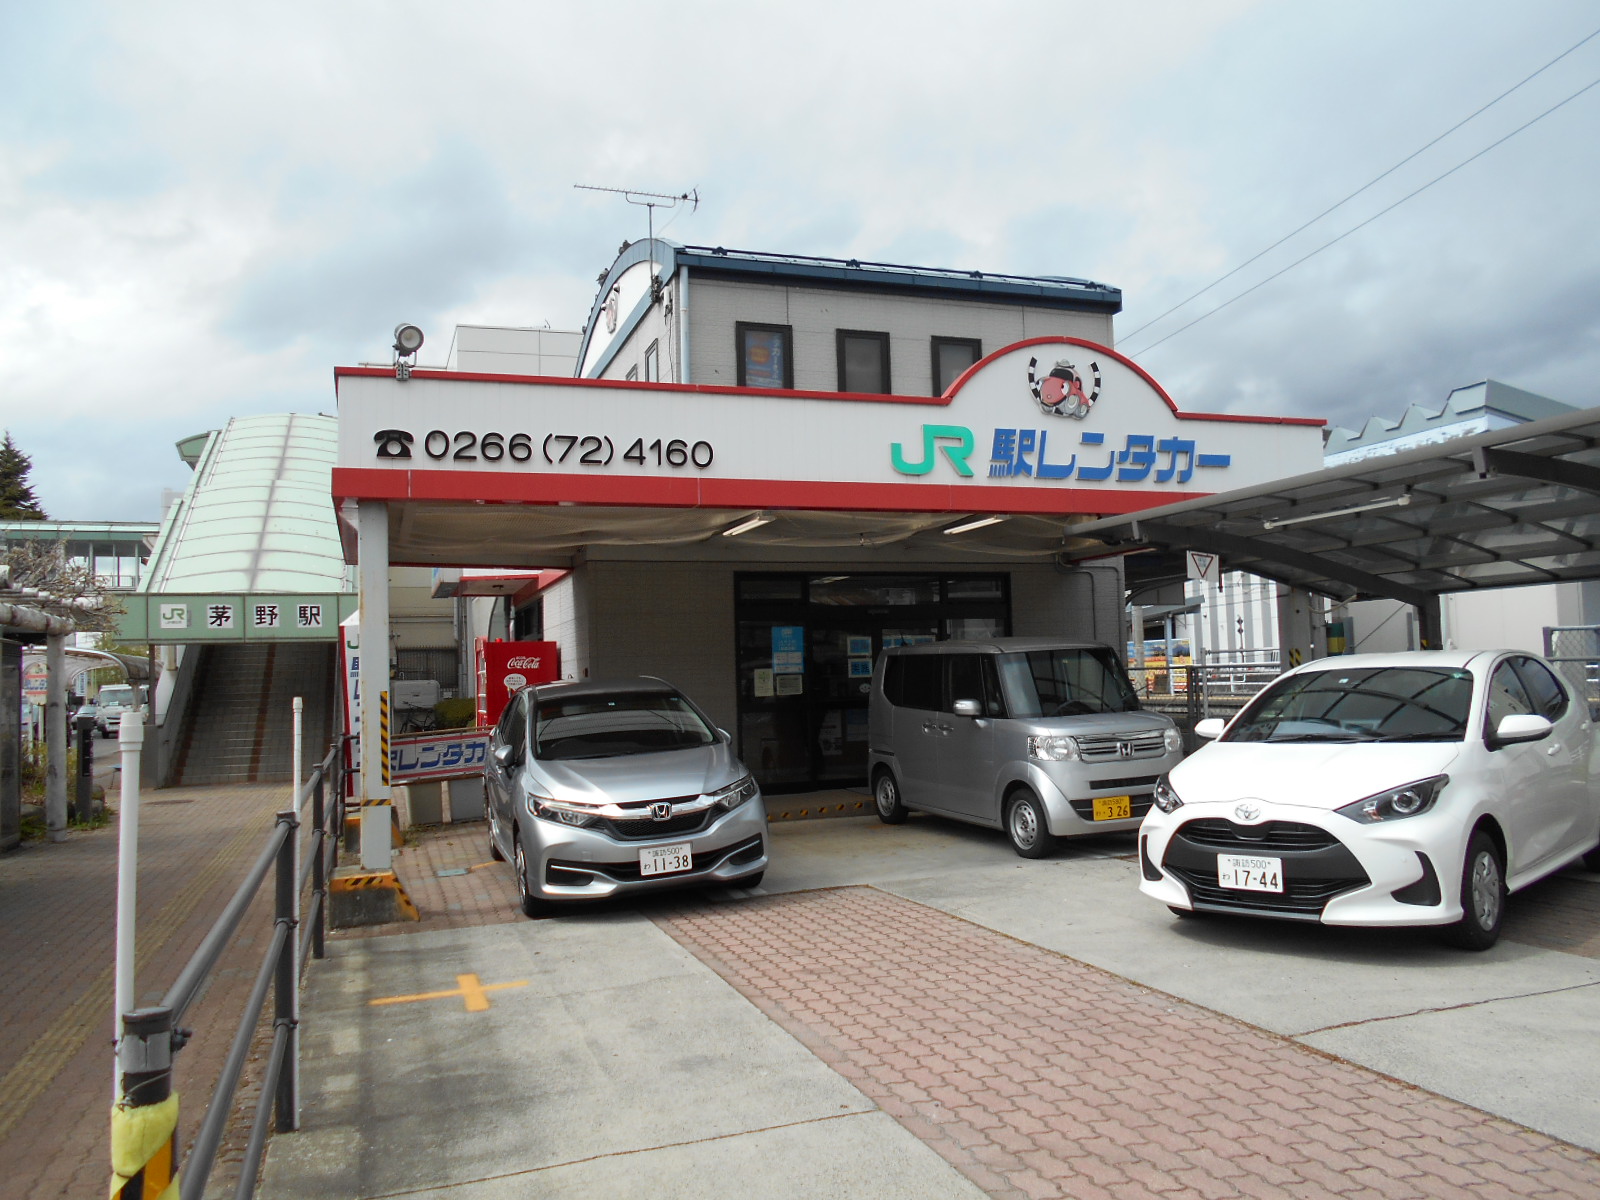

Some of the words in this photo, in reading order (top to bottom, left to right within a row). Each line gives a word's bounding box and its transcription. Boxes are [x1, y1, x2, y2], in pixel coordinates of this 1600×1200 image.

[891, 424, 974, 477] JR
[987, 428, 1231, 483] 駅レンタカー
[162, 608, 185, 620] JR
[654, 854, 689, 872] 11-38
[1234, 869, 1279, 889] 17-44
